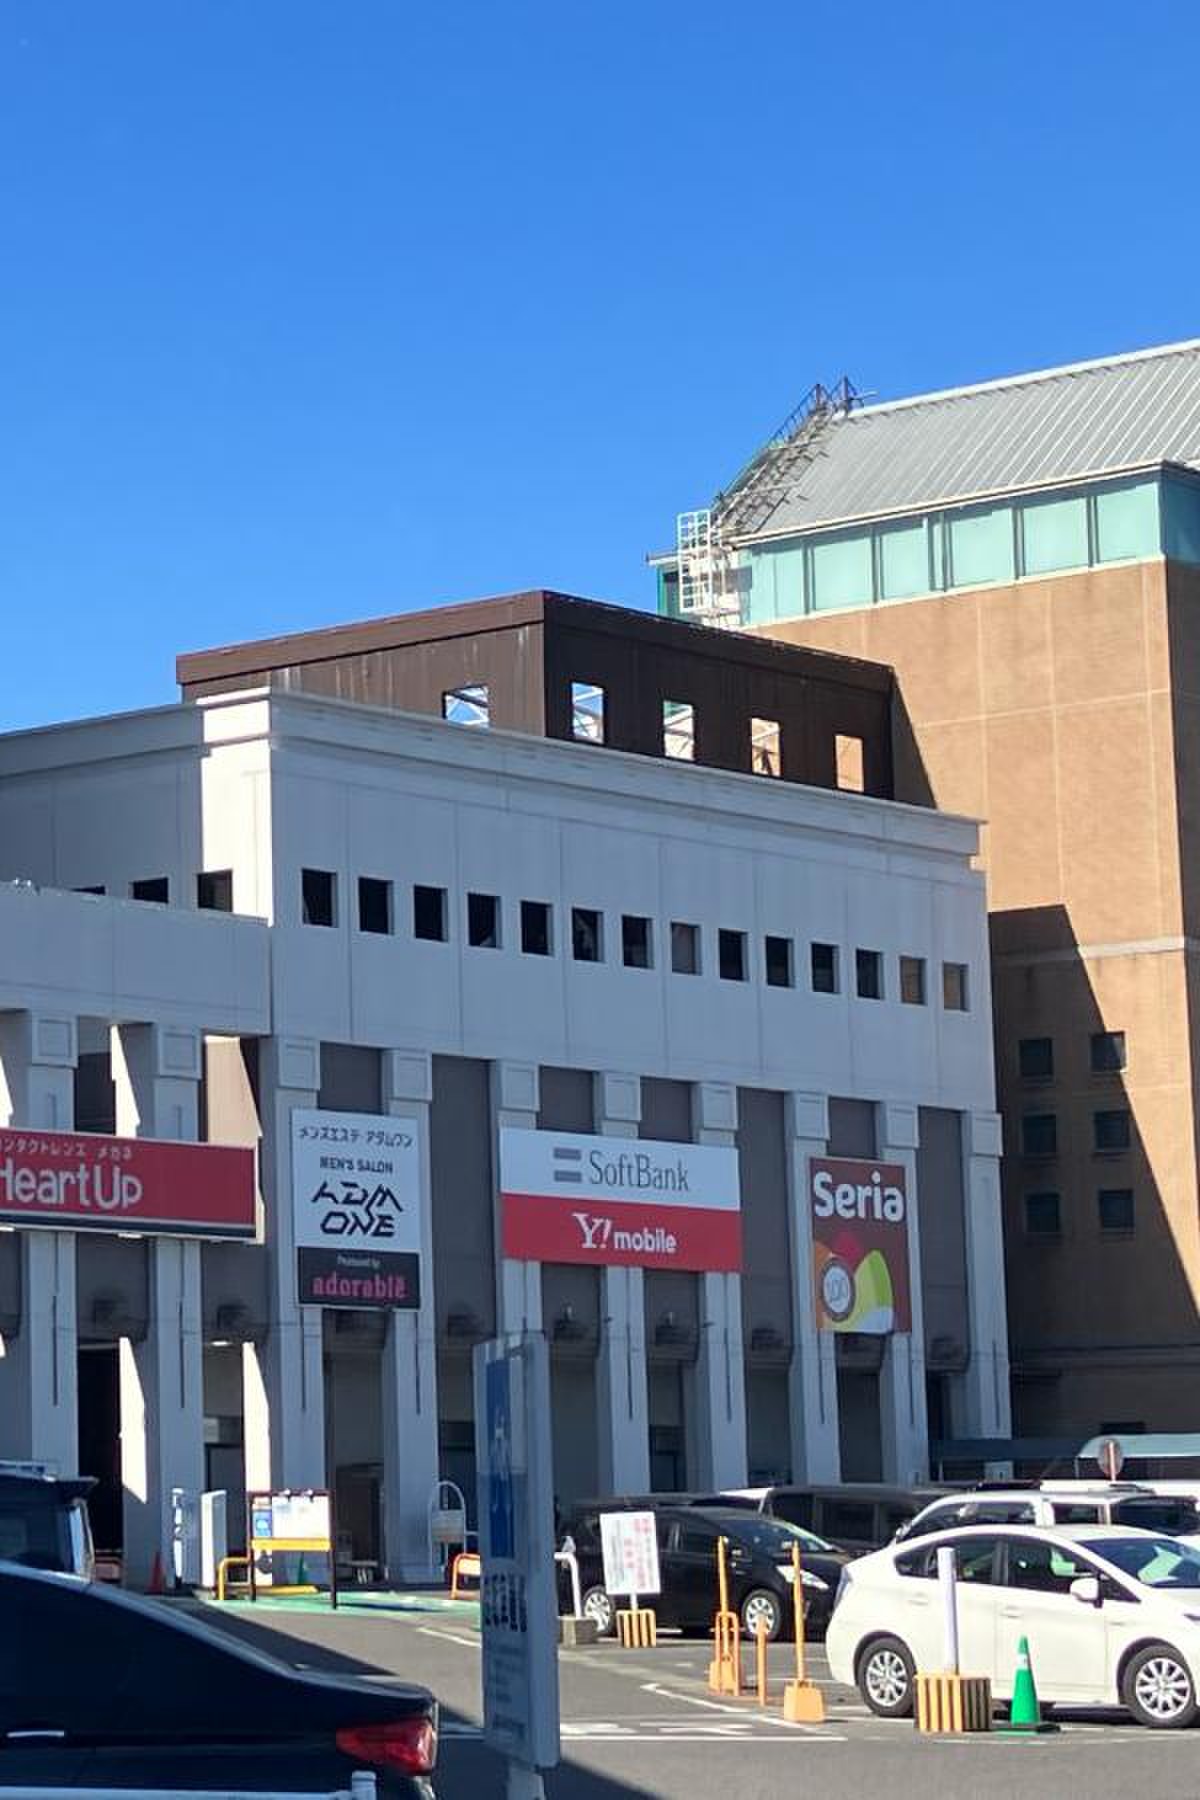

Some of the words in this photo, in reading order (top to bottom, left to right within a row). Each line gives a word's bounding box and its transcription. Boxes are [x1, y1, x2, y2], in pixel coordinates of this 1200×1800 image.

[357, 1158, 393, 1174] SALON
[589, 1150, 690, 1193] SoftBank
[813, 1170, 904, 1222] Seria
[320, 1211, 396, 1237] ONE
[312, 1271, 408, 1300] adorable
